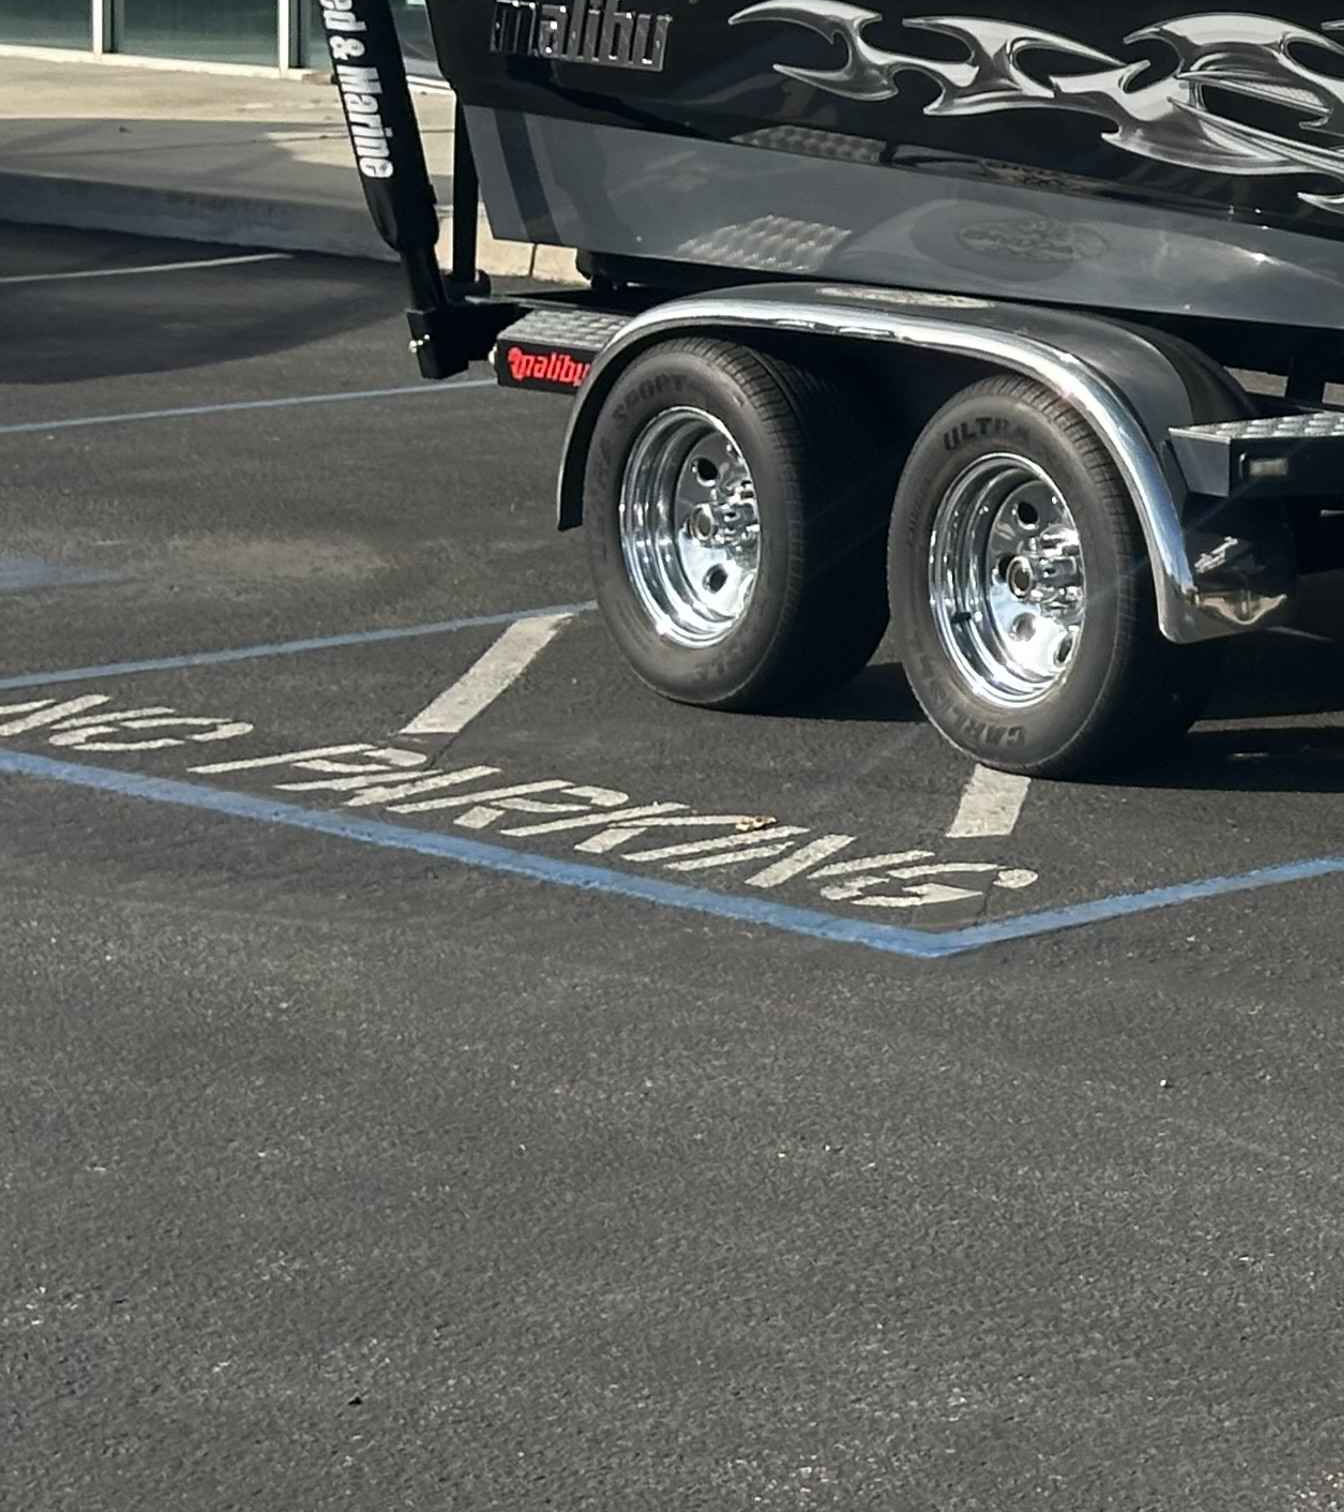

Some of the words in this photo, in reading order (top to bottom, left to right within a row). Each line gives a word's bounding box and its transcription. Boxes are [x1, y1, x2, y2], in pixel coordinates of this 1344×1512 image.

[328, 34, 366, 60] &
[335, 63, 395, 180] Marine
[186, 742, 1039, 909] PARKING
